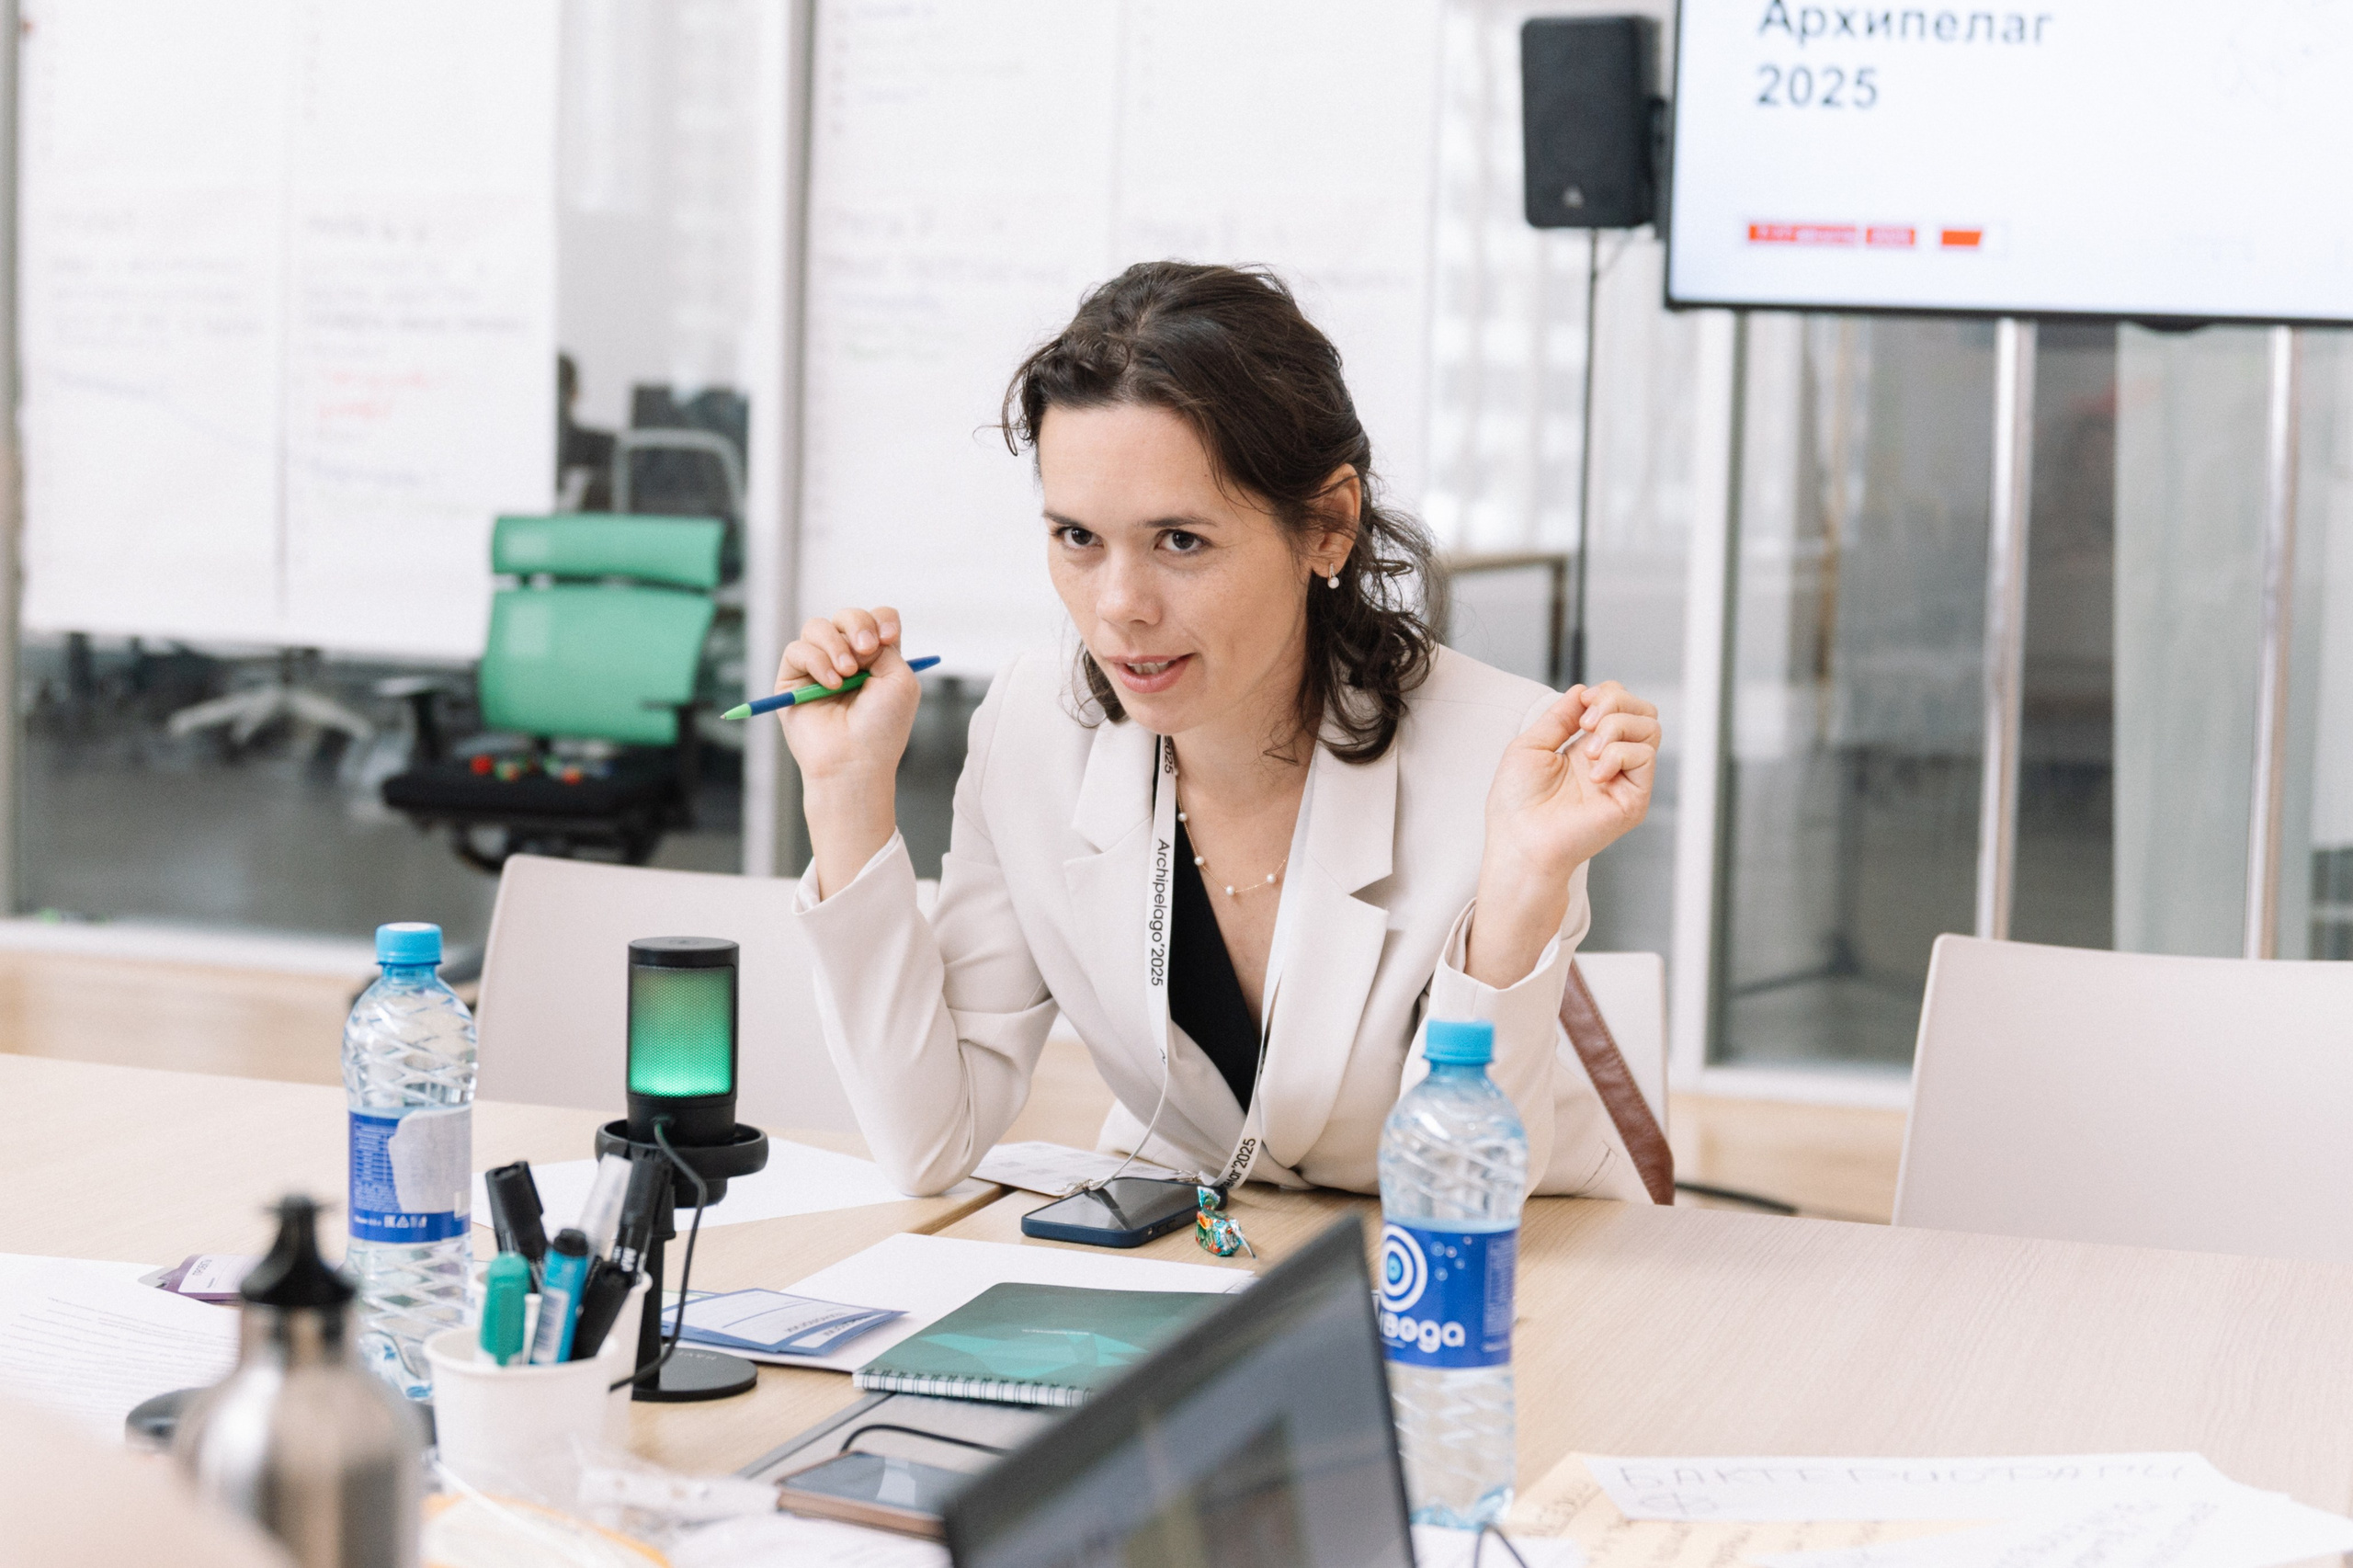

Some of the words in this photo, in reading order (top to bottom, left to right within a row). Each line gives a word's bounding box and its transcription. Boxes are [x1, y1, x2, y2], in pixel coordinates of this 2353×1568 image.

[1757, 0, 2054, 46] Архипелаг
[1756, 64, 1880, 108] 2025
[1149, 838, 1170, 986] Archipelago'2025
